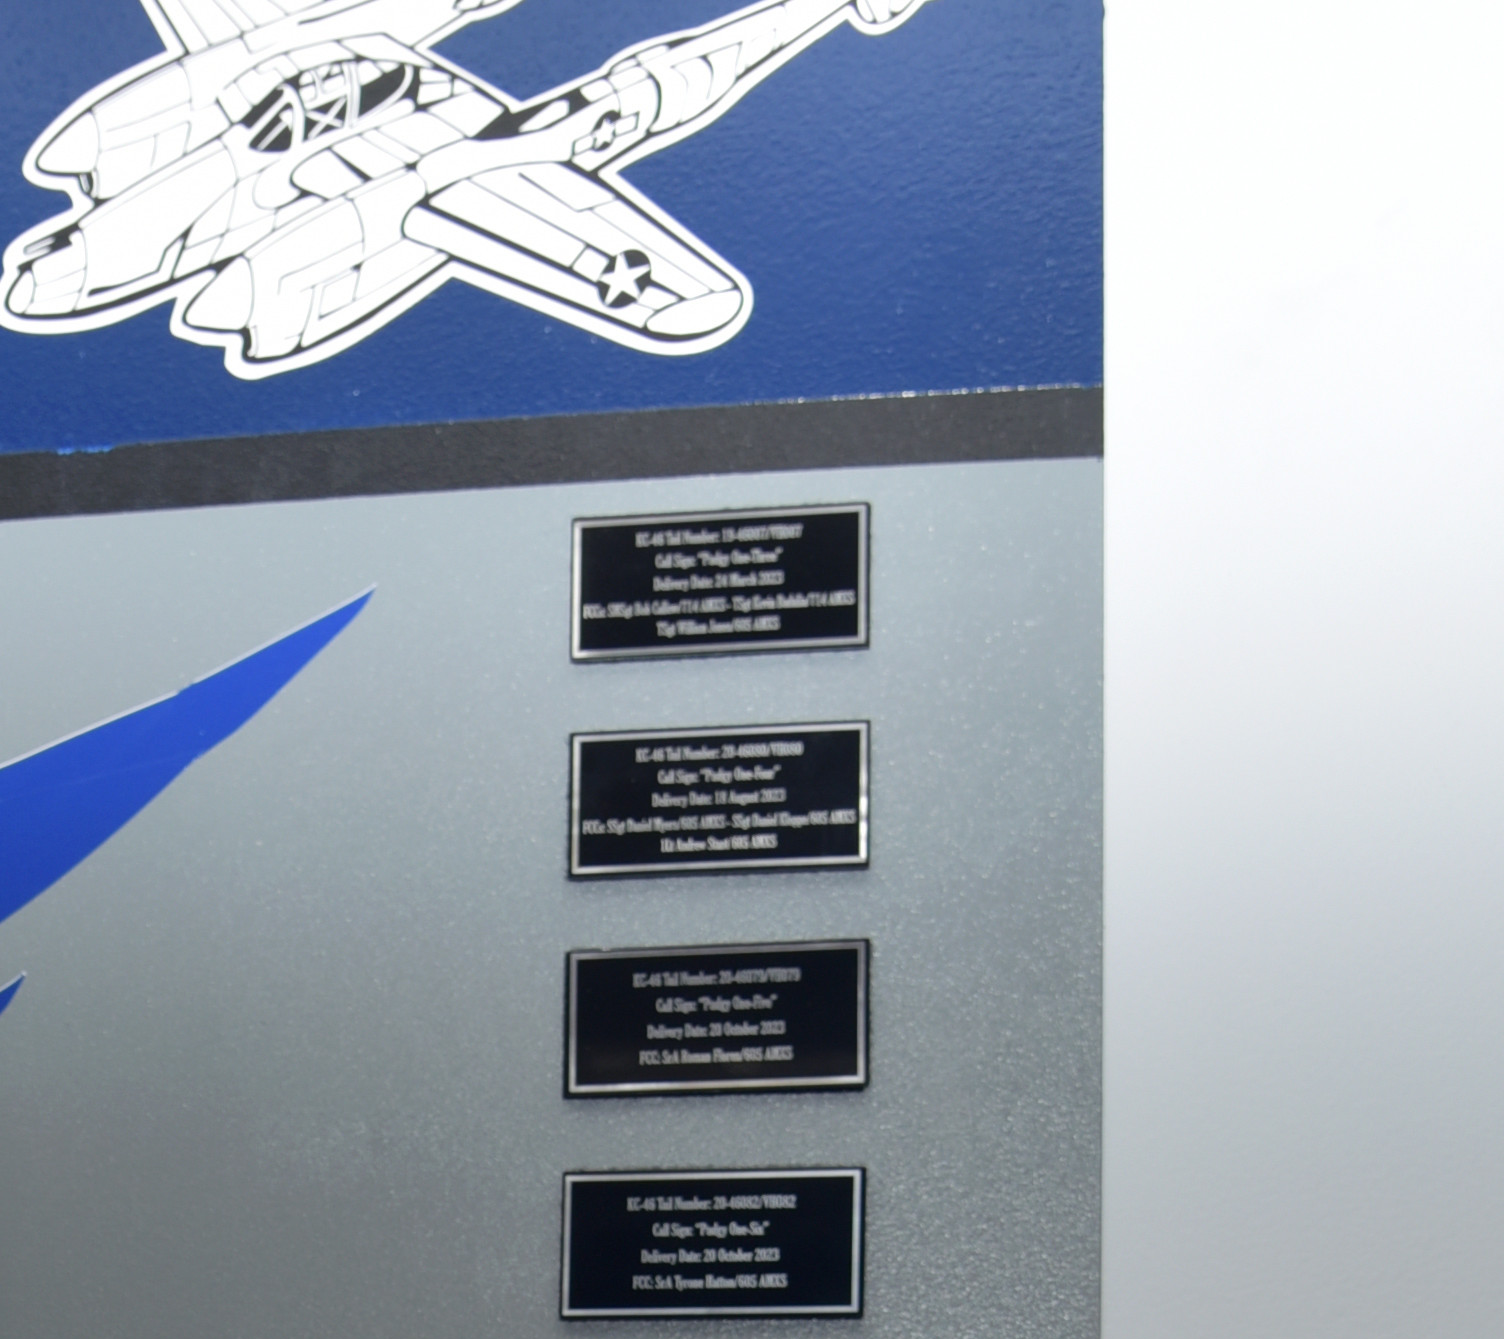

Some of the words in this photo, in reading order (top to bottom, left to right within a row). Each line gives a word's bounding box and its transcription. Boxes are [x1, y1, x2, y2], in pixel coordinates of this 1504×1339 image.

[651, 792, 688, 808] Delivery
[647, 1024, 684, 1040] Delivery
[627, 1197, 656, 1211] KC-46
[641, 1249, 678, 1265] Delivery
[717, 1248, 754, 1262] October
[754, 1247, 781, 1262] 2023
